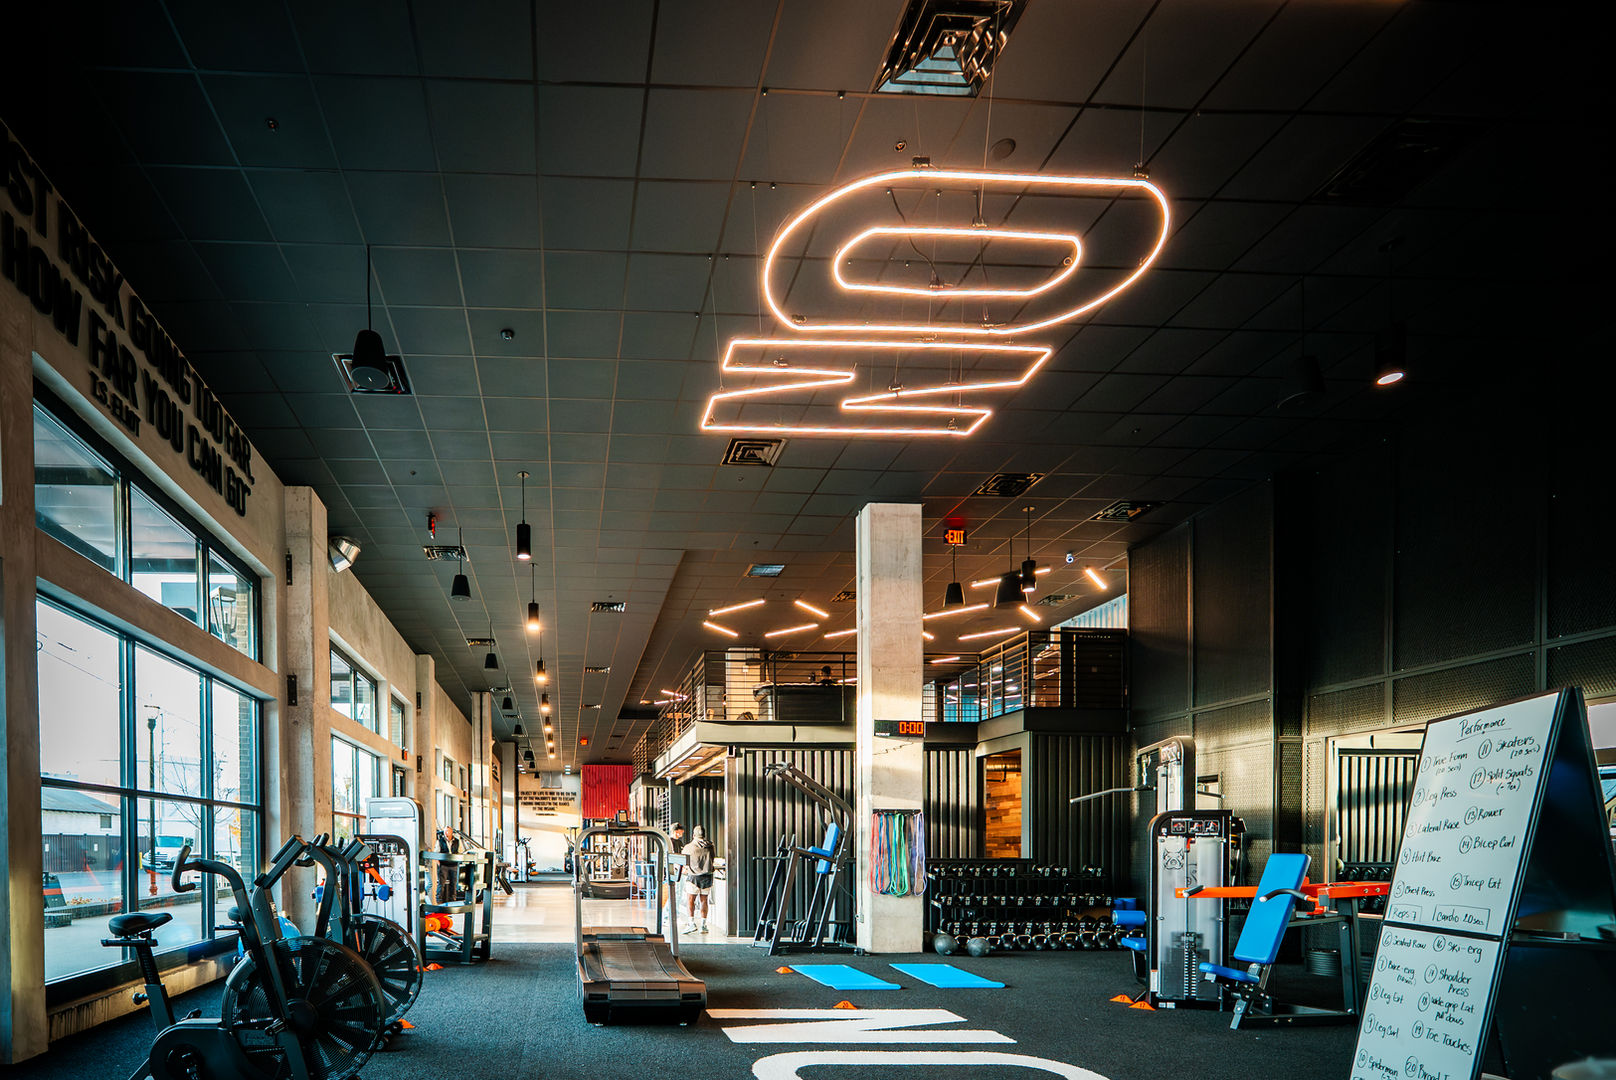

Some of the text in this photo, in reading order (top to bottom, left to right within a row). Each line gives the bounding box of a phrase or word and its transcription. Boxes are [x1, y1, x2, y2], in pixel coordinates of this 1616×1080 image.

[58, 200, 125, 330] RISK
[130, 295, 191, 405] GOING
[192, 371, 223, 445] TOO
[1, 211, 83, 348] HOW
[89, 310, 139, 411] FAR
[142, 368, 183, 454] YOU
[189, 425, 223, 495] CAN
[948, 529, 965, 544] EXIT
[899, 721, 924, 735] 0:00
[1459, 717, 1506, 737] Performance
[1496, 735, 1535, 752] Skaters
[1487, 768, 1503, 784] Split
[1505, 764, 1534, 784] Squats
[1440, 786, 1458, 800] Press
[1478, 808, 1504, 821] Rower
[1417, 821, 1441, 834] Lateral
[1473, 836, 1498, 849] Bicep
[1499, 835, 1516, 849] Curl
[1404, 885, 1419, 896] Chest
[1436, 908, 1460, 923] Cardio
[1412, 938, 1427, 950] Row
[1438, 968, 1472, 985] Shoulder
[1380, 988, 1391, 1004] Leg
[1447, 983, 1470, 997] Press
[1374, 1021, 1387, 1038] Leg
[1442, 1032, 1473, 1056] Touches
[1368, 1055, 1399, 1077] Spiderman
